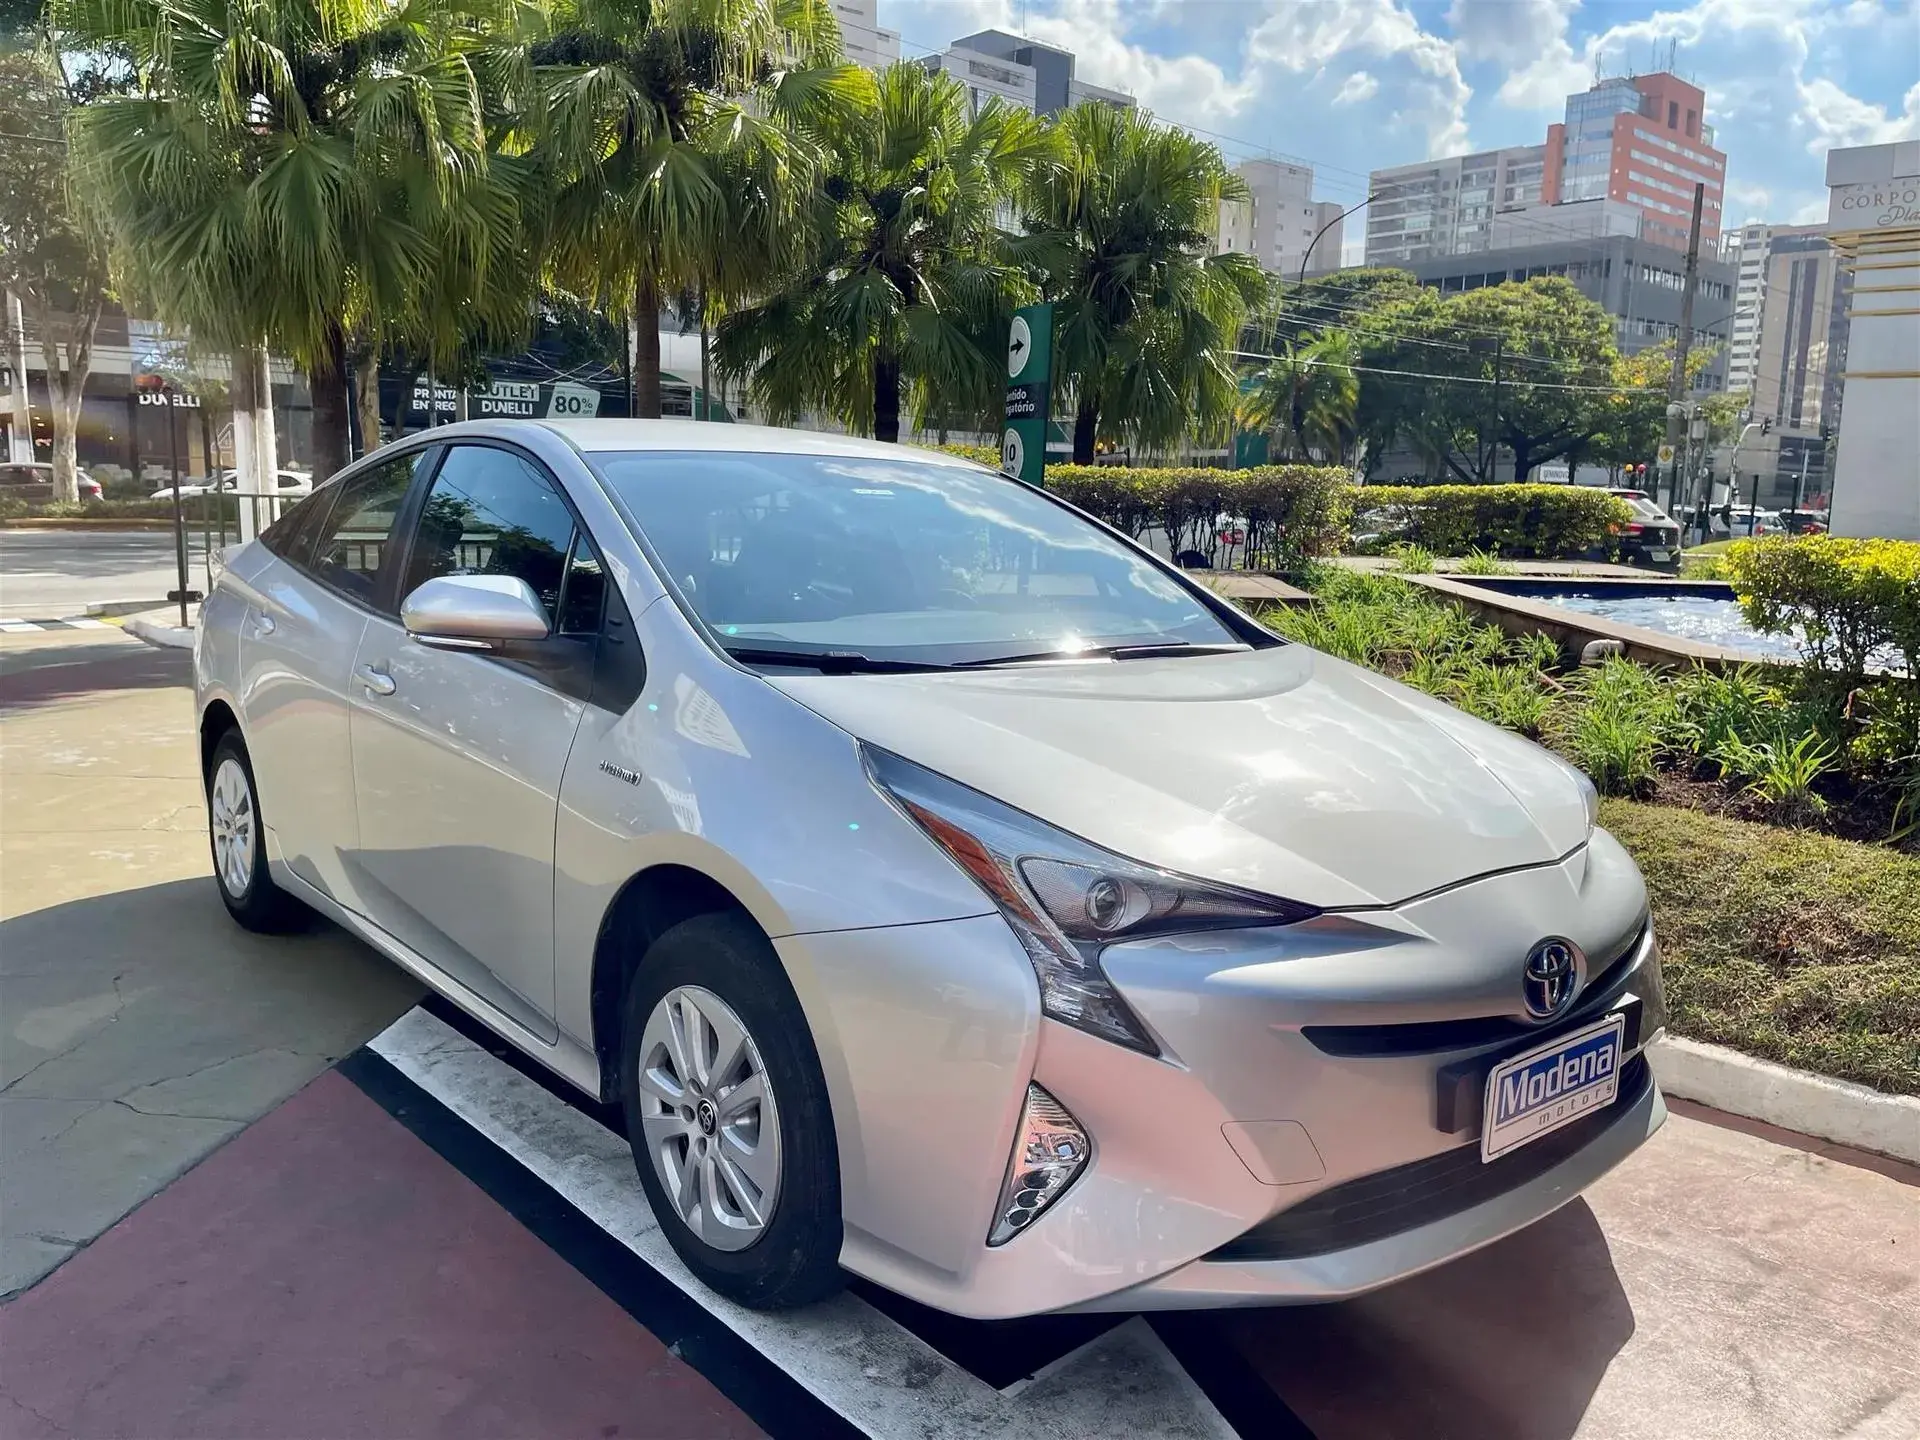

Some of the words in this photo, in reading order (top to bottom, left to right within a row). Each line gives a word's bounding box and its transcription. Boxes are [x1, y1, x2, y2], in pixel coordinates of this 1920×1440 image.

[1842, 189, 1917, 210] CORPO
[413, 400, 457, 411] ENREG
[481, 400, 533, 415] DUNELLI
[1500, 1043, 1614, 1119] Modena
[1538, 1082, 1613, 1126] motors
